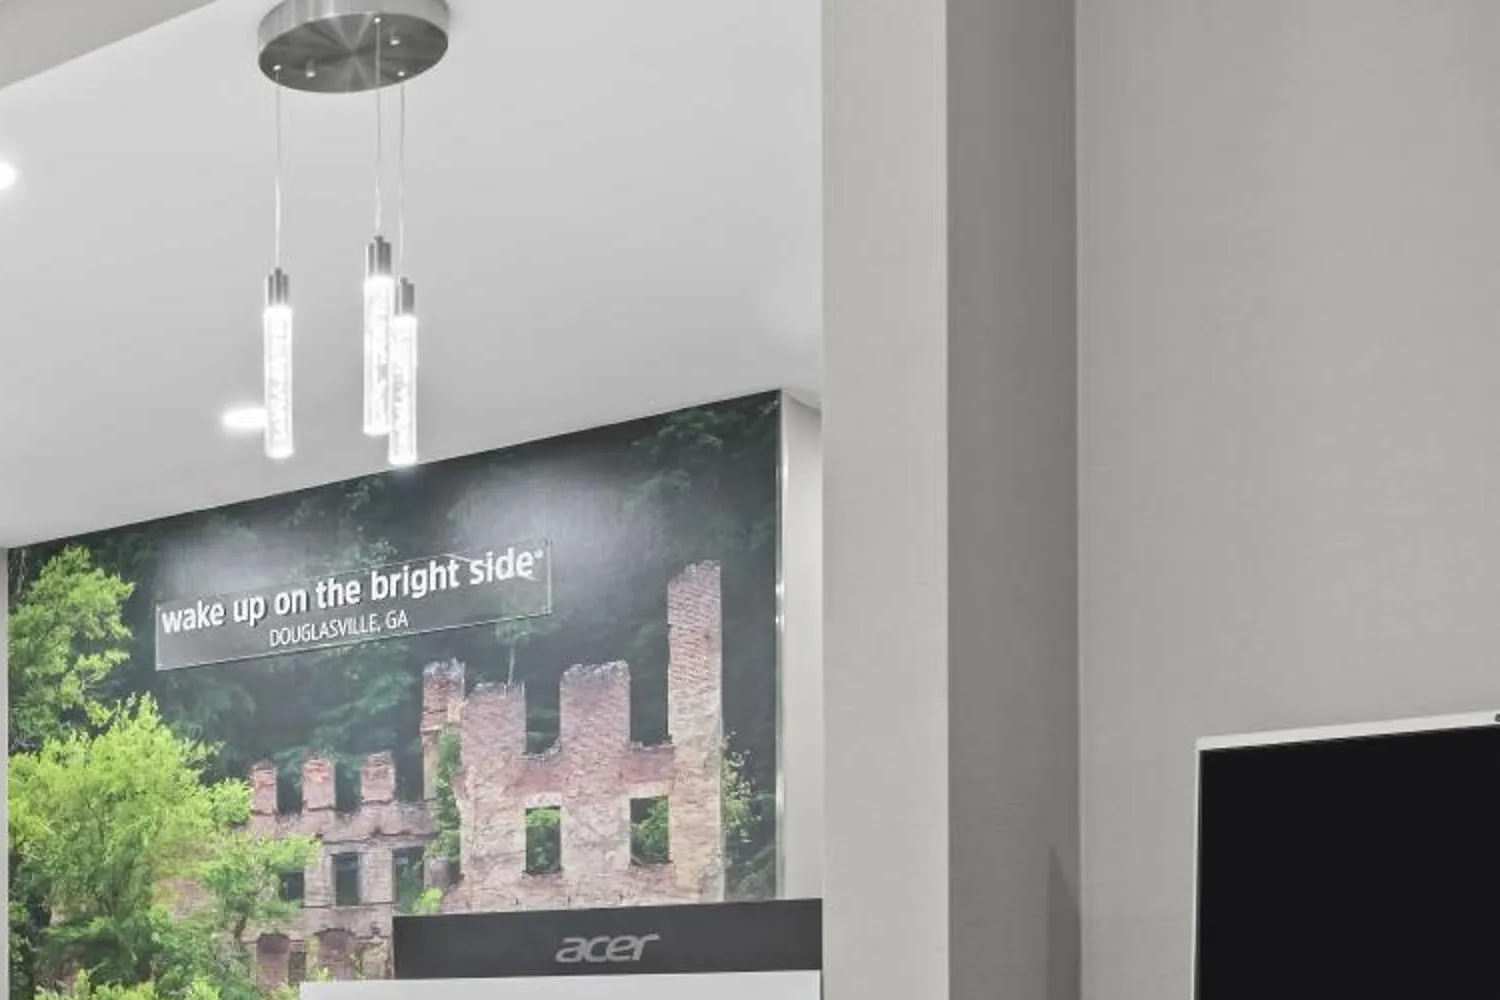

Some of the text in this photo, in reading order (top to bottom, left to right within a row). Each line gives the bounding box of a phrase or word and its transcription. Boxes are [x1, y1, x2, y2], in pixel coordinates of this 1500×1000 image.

[161, 600, 225, 635] wake
[233, 595, 266, 628] up
[274, 588, 308, 616] on
[316, 577, 361, 609] the
[371, 560, 461, 600] bright
[269, 609, 409, 647] DOUGLASVILLE, GA
[555, 933, 660, 962] acer
